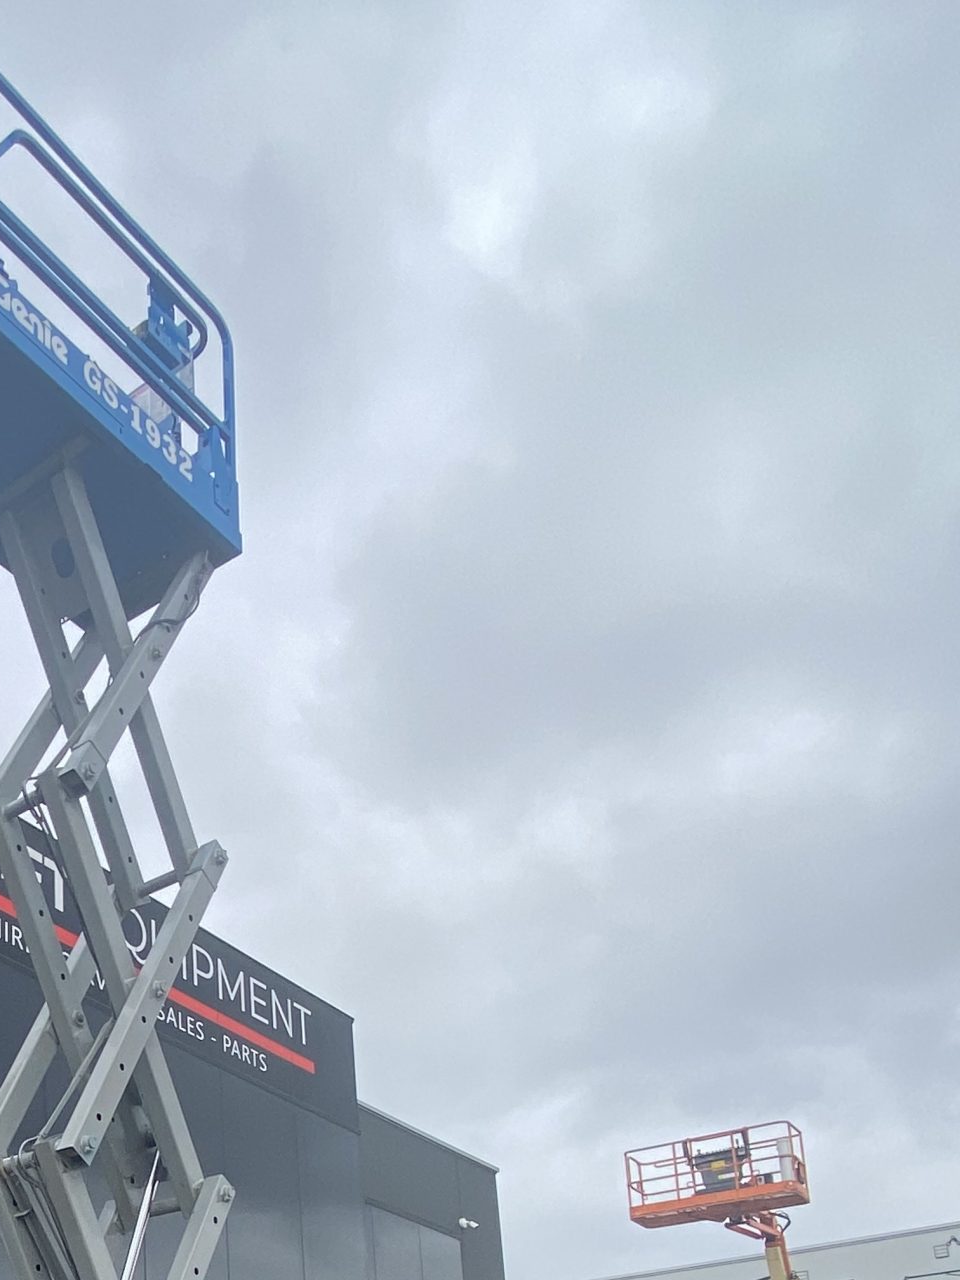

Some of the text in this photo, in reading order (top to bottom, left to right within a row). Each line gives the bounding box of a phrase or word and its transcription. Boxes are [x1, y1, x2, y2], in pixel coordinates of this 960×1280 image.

[83, 359, 193, 483] GS-1932
[156, 1007, 205, 1041] SALES
[223, 1034, 268, 1072] PARTS
